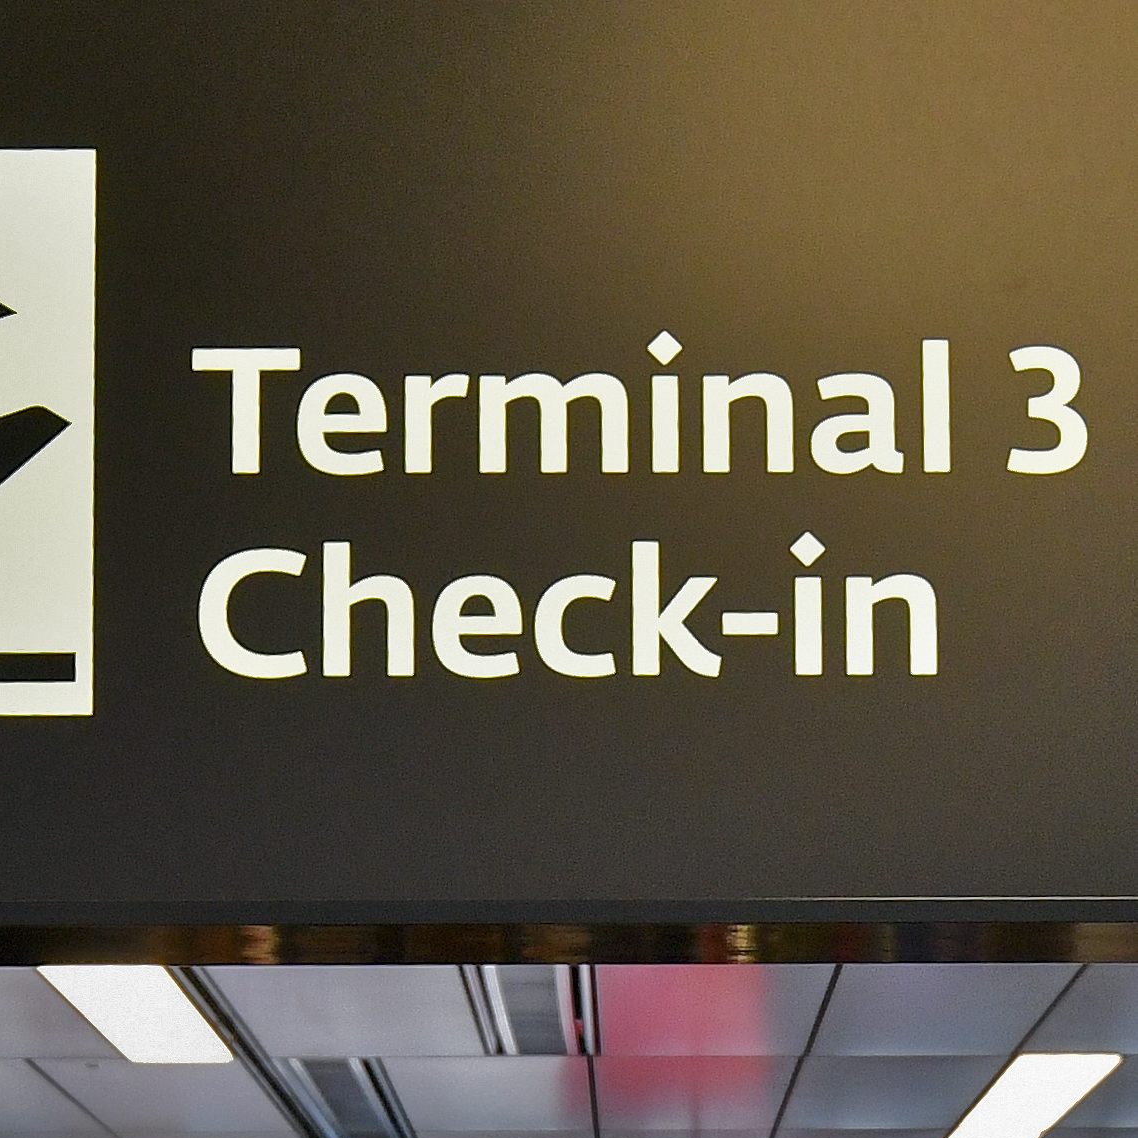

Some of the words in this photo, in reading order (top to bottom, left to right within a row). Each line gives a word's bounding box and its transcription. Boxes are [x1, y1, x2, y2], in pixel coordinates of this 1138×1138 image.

[192, 330, 951, 475] Terminal
[1006, 345, 1090, 475] 3
[197, 531, 940, 679] Check-in
